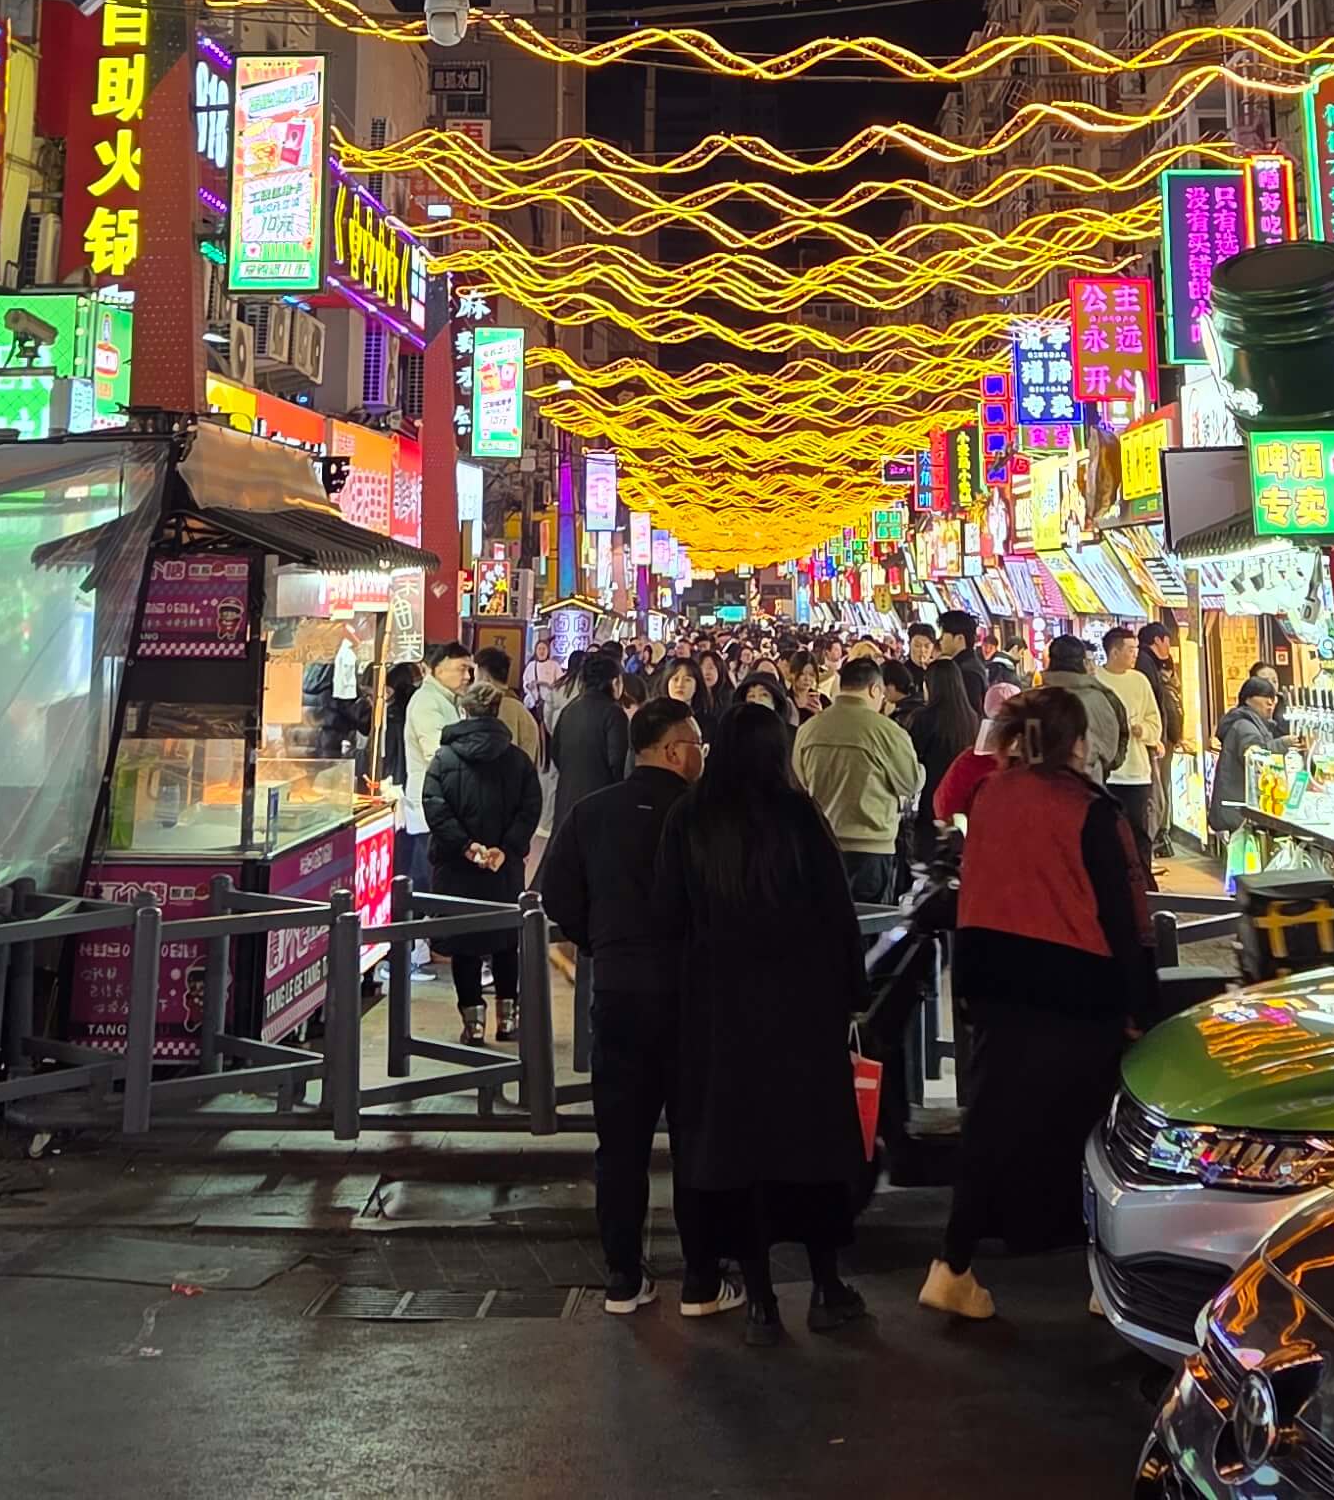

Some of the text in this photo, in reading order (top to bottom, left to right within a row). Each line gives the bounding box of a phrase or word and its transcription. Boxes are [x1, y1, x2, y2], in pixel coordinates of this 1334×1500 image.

[1214, 187, 1239, 264] 只有选
[1081, 284, 1141, 312] 公主
[1081, 325, 1143, 353] 永远
[1257, 442, 1324, 481] 啤酒
[1260, 487, 1328, 527] 专卖
